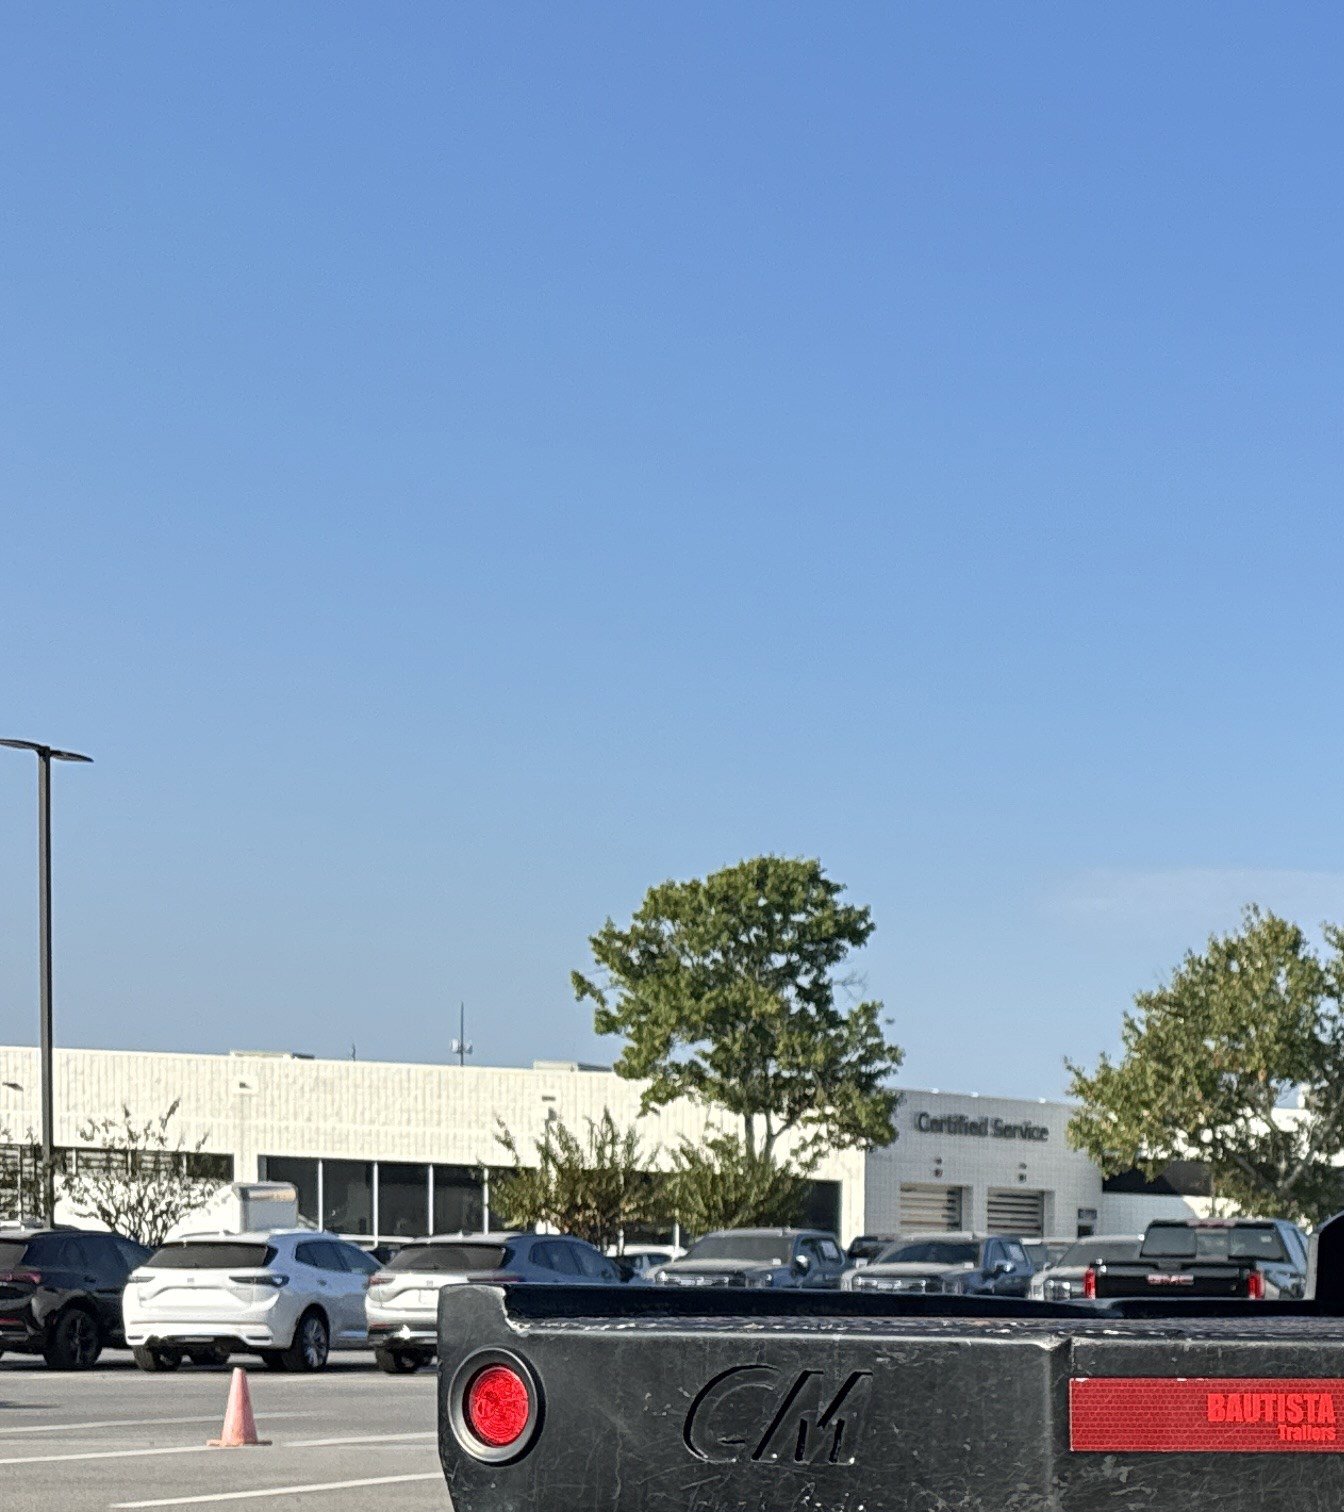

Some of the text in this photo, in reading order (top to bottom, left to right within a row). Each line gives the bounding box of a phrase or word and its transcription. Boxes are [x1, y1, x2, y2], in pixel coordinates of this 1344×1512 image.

[914, 1111, 1049, 1141] Certified Service
[683, 1363, 874, 1466] CM
[1207, 1393, 1337, 1423] BAUTISTA
[1277, 1424, 1337, 1441] Trailers
